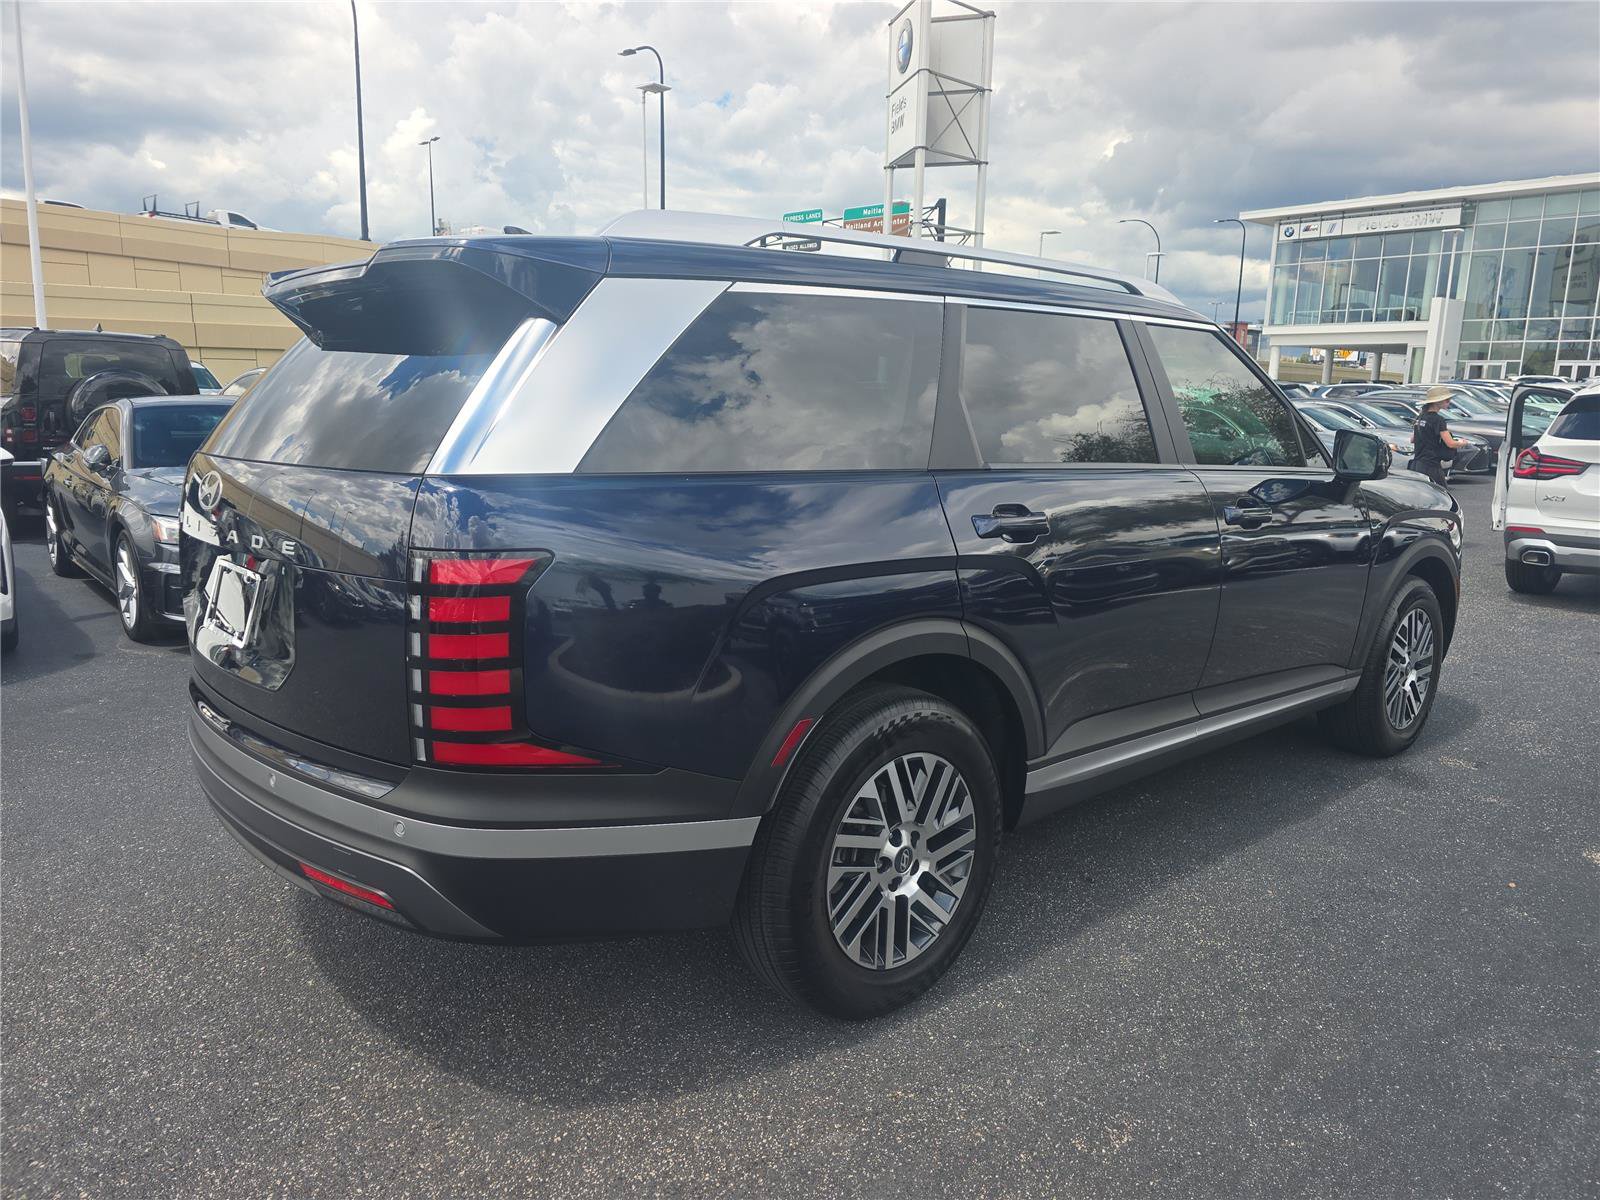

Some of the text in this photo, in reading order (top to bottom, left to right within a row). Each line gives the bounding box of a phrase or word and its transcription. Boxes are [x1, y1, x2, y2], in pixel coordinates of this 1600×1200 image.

[863, 207, 885, 215] Maitlan
[784, 212, 822, 222] EXPRESS LANES
[186, 515, 296, 555] LISADE
